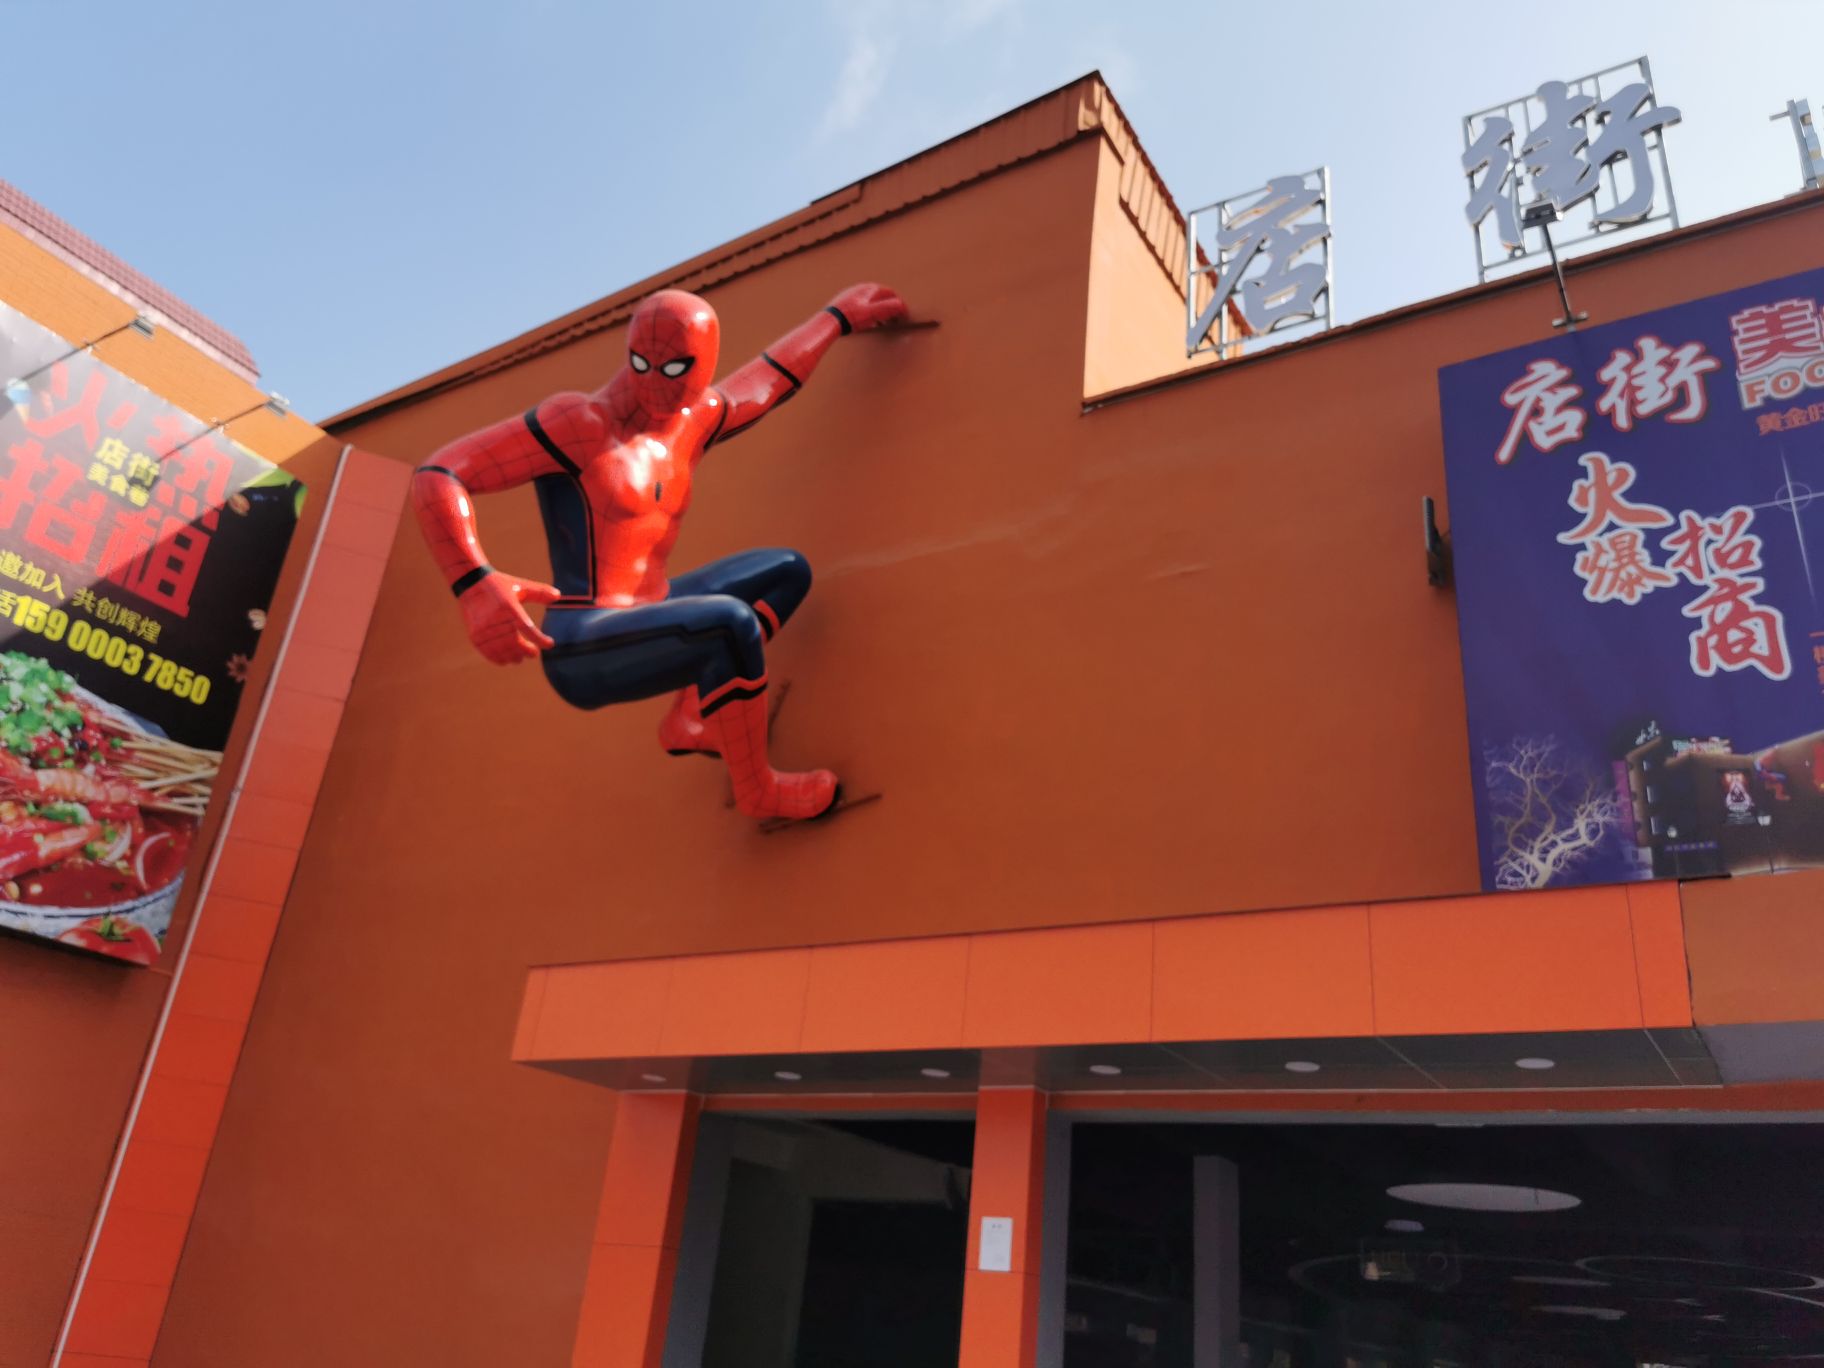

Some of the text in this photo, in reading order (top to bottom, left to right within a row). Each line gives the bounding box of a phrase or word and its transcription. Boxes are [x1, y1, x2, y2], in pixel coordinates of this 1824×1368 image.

[25, 360, 235, 532] 火热
[95, 437, 160, 488] 店街
[1494, 334, 1721, 465] 店街
[0, 438, 214, 619] 招租
[1557, 451, 1678, 605] 火爆
[1660, 505, 1792, 680] 招商
[67, 619, 144, 676] 0003
[142, 652, 212, 705] 7850
[71, 586, 162, 645] 共创辉煌
